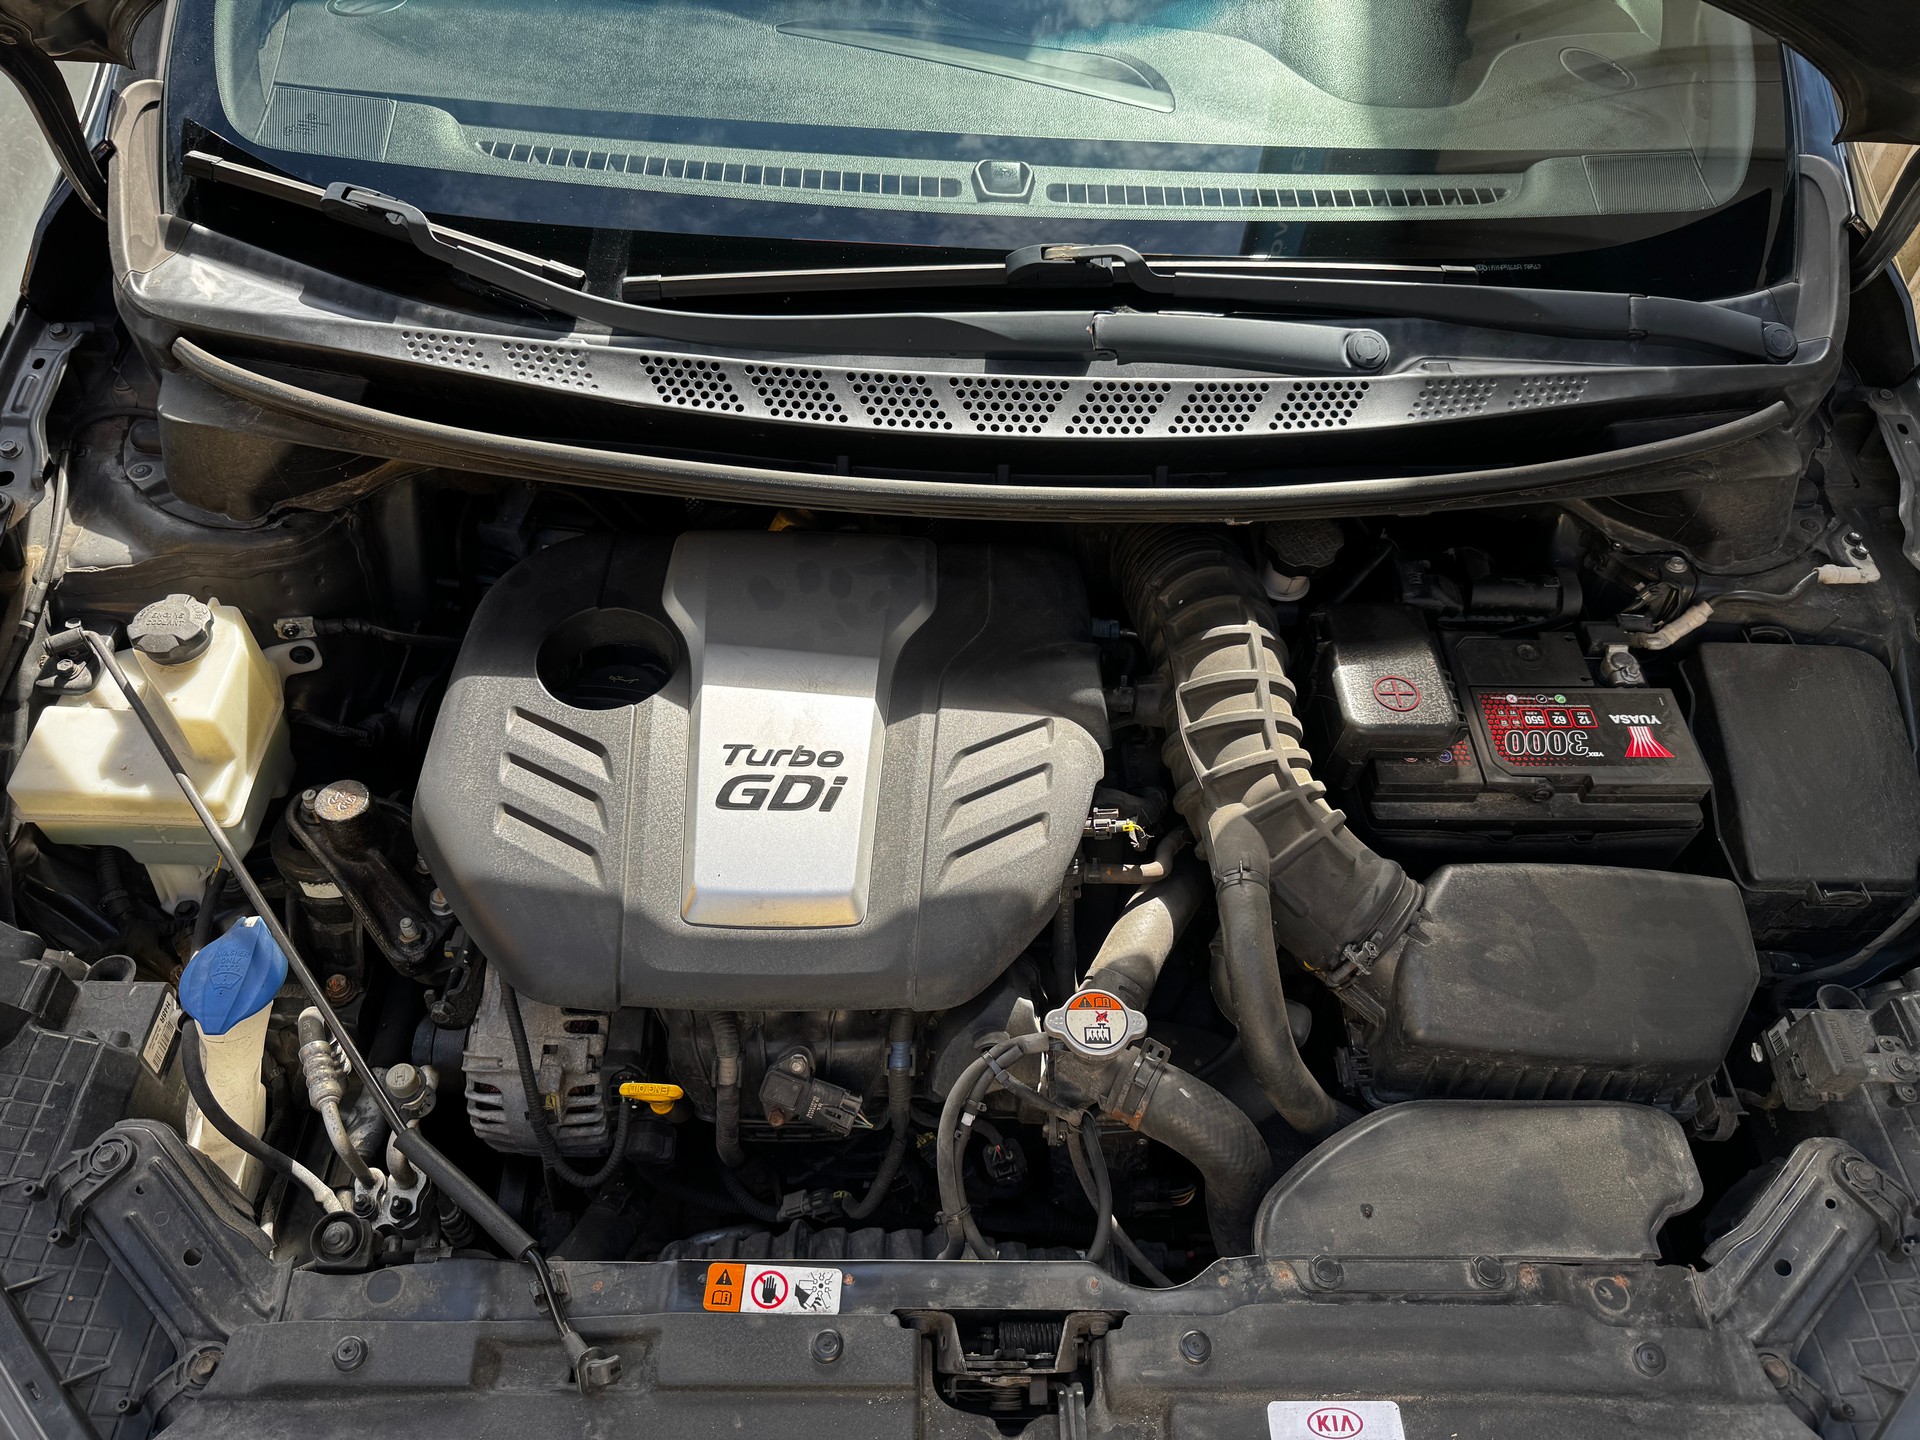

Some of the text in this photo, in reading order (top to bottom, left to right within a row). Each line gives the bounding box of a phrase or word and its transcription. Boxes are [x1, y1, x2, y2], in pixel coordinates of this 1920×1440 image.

[1524, 715, 1545, 725] 550
[1551, 715, 1567, 725] 62
[1579, 715, 1592, 725] 12
[1608, 714, 1662, 725] YUASA
[1504, 729, 1589, 756] 3000
[722, 743, 845, 768] Turbo
[714, 773, 849, 812] GDi
[218, 950, 249, 958] WASHER
[629, 1084, 668, 1093] ENG OIL
[1315, 1414, 1356, 1432] KIA
